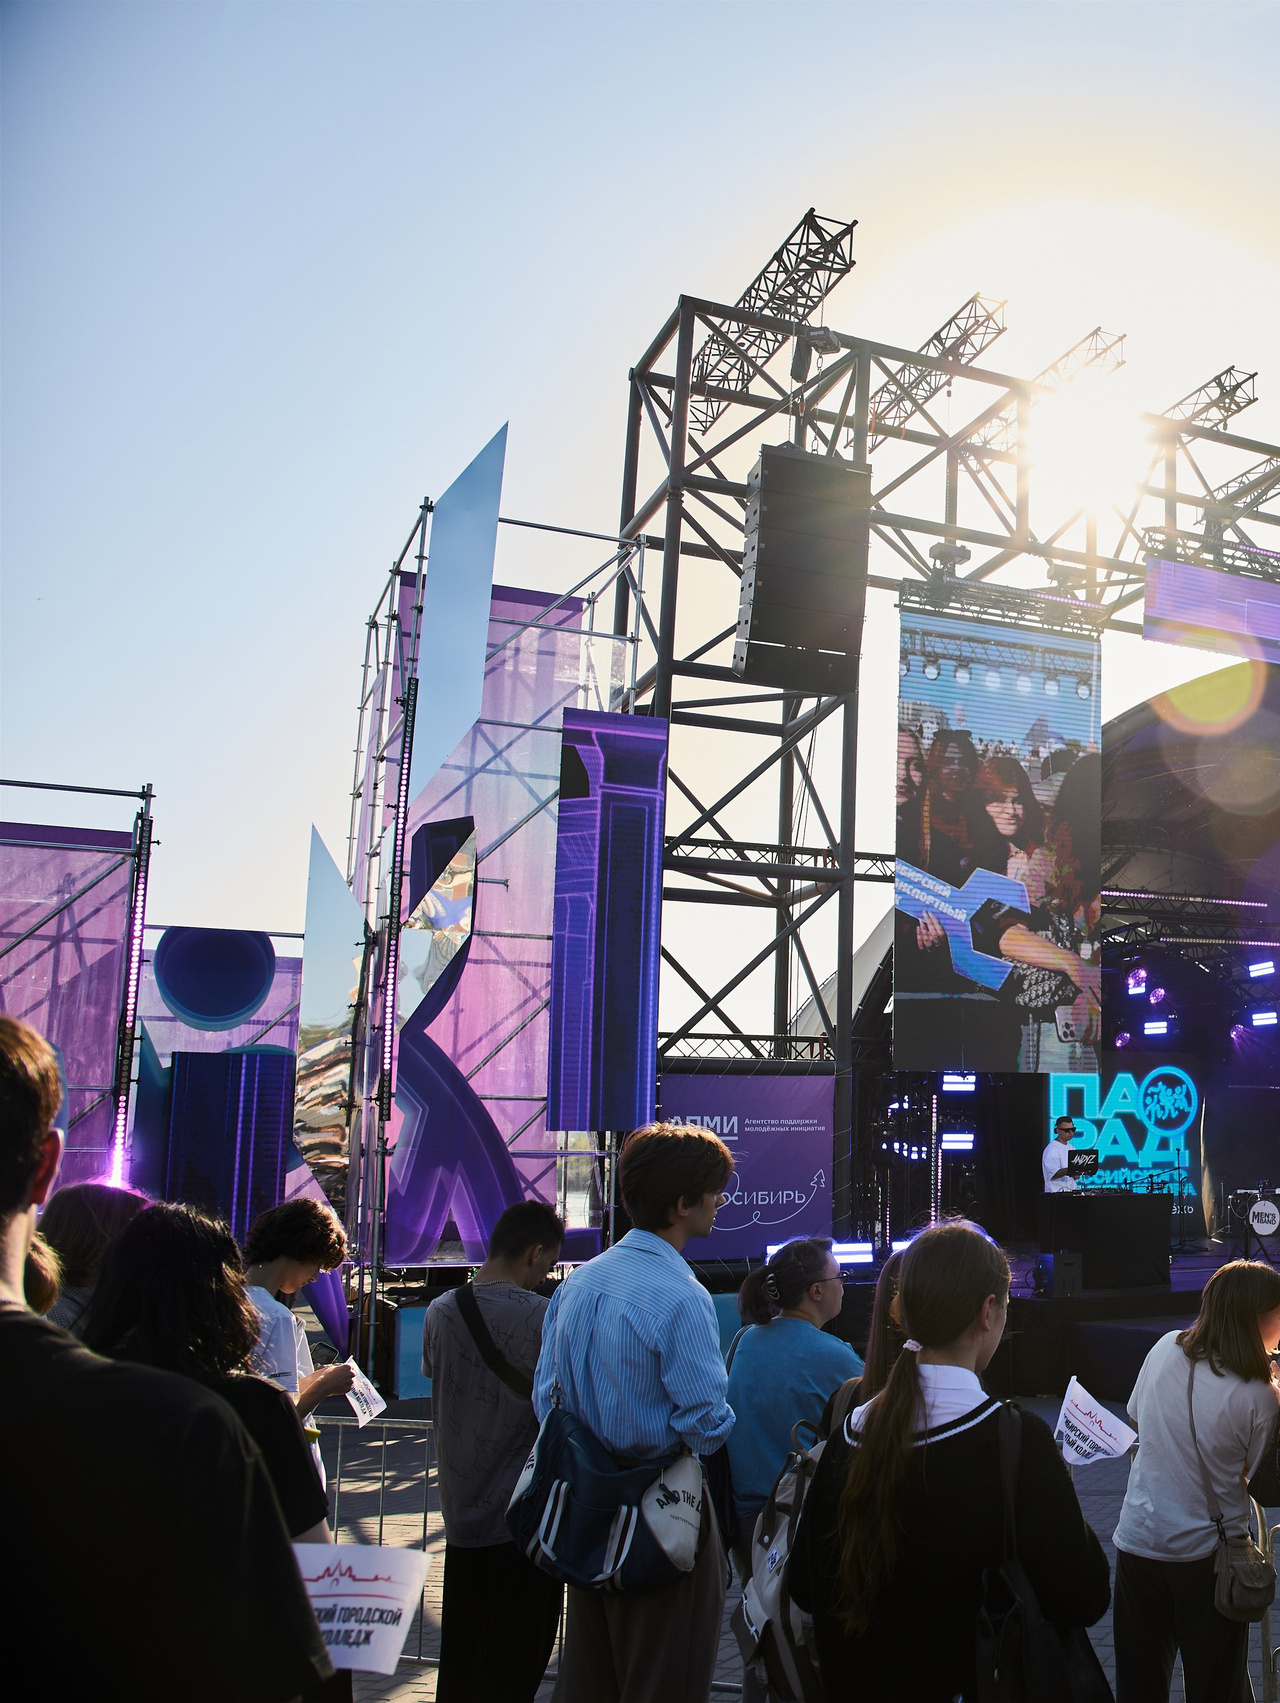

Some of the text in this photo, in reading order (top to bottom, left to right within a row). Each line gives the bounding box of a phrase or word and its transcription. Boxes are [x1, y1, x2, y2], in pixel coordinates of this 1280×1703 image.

[1050, 1073, 1141, 1119] ПА
[780, 1118, 818, 1126] поддержки
[721, 1190, 806, 1205] ОСИБИРЬ
[1260, 1218, 1277, 1226] BAND
[682, 1490, 696, 1508] THE
[337, 1606, 402, 1627] ГОРОДСКОЙ
